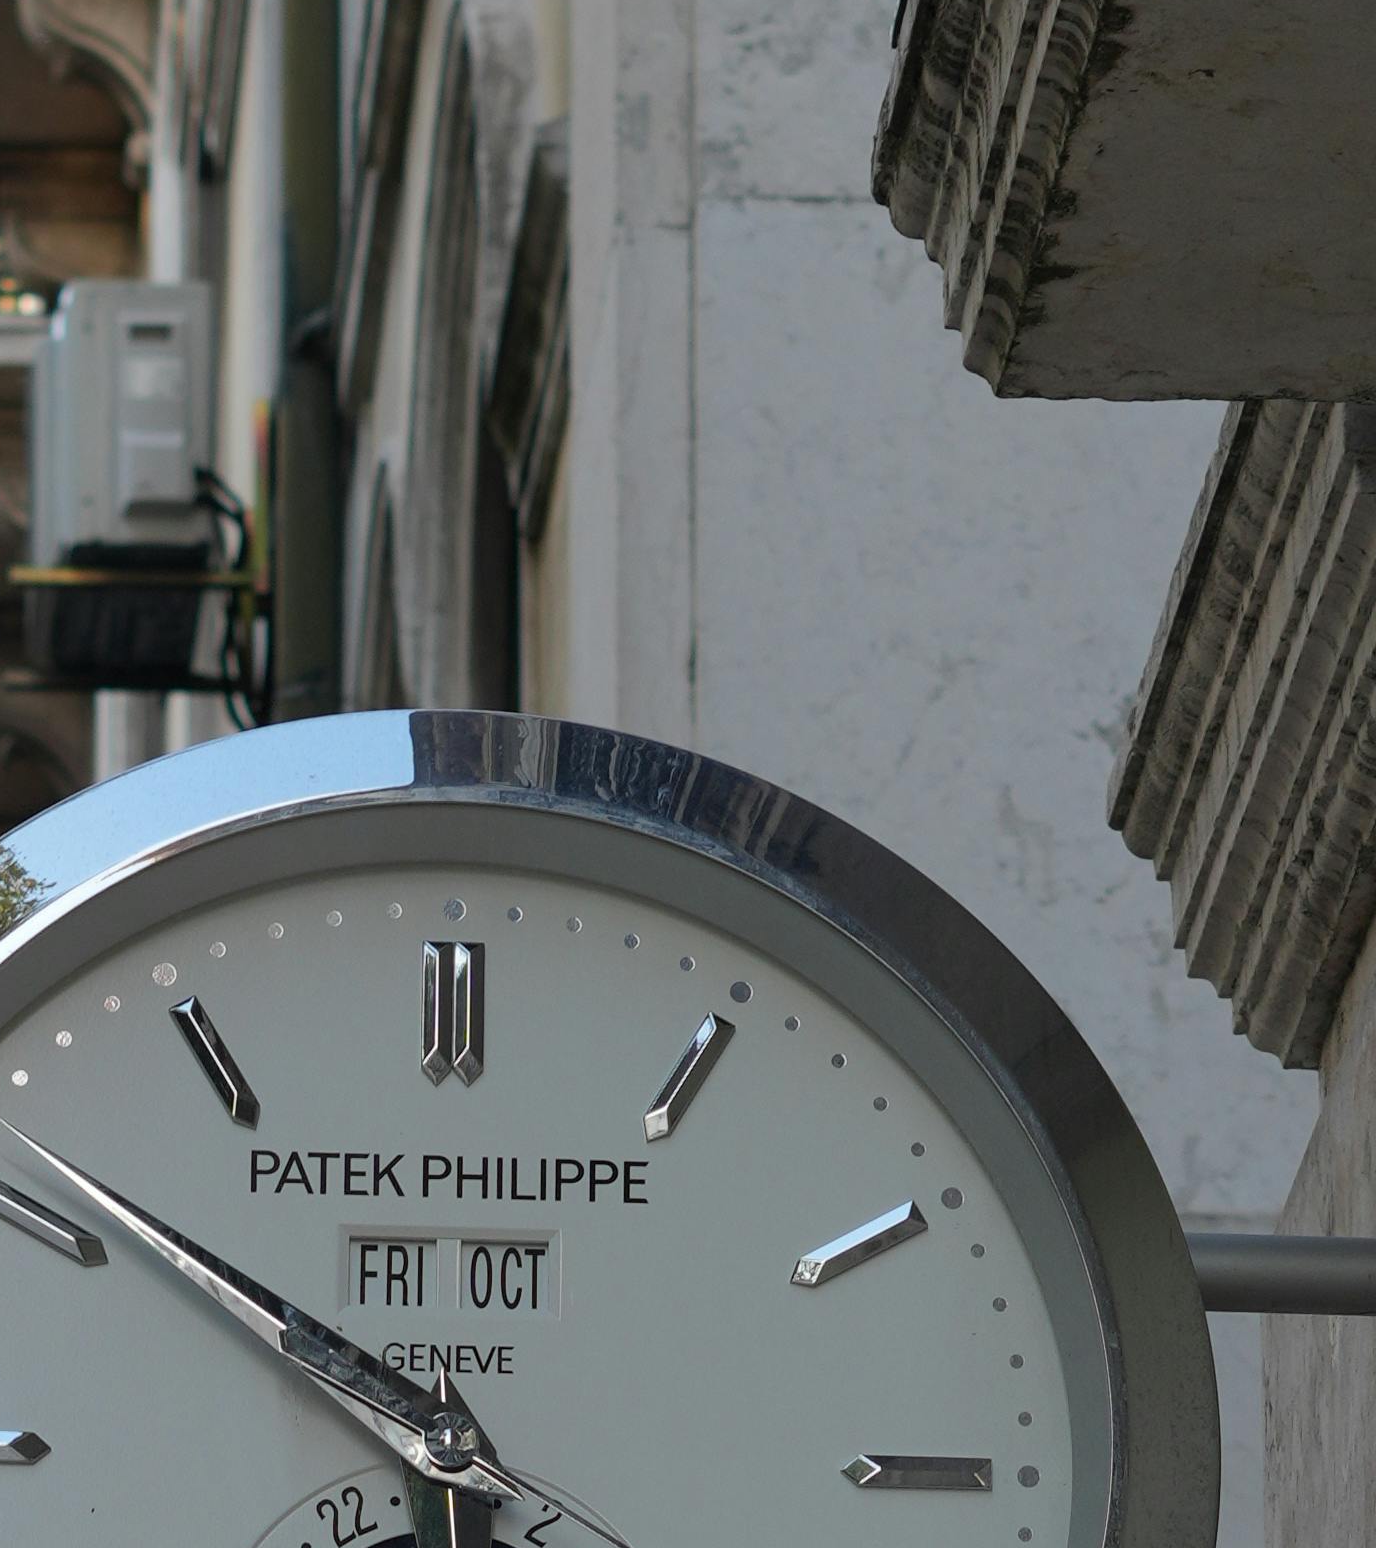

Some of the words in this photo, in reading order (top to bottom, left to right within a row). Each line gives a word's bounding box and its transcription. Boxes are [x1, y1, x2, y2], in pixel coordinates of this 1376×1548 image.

[249, 1149, 406, 1198] PATEK
[421, 1154, 650, 1204] PHILIPPE
[358, 1243, 424, 1307] FRI
[470, 1245, 546, 1310] OCT
[382, 1342, 515, 1375] GENEVE
[316, 1486, 378, 1548] 22
[523, 1503, 564, 1548] 2
